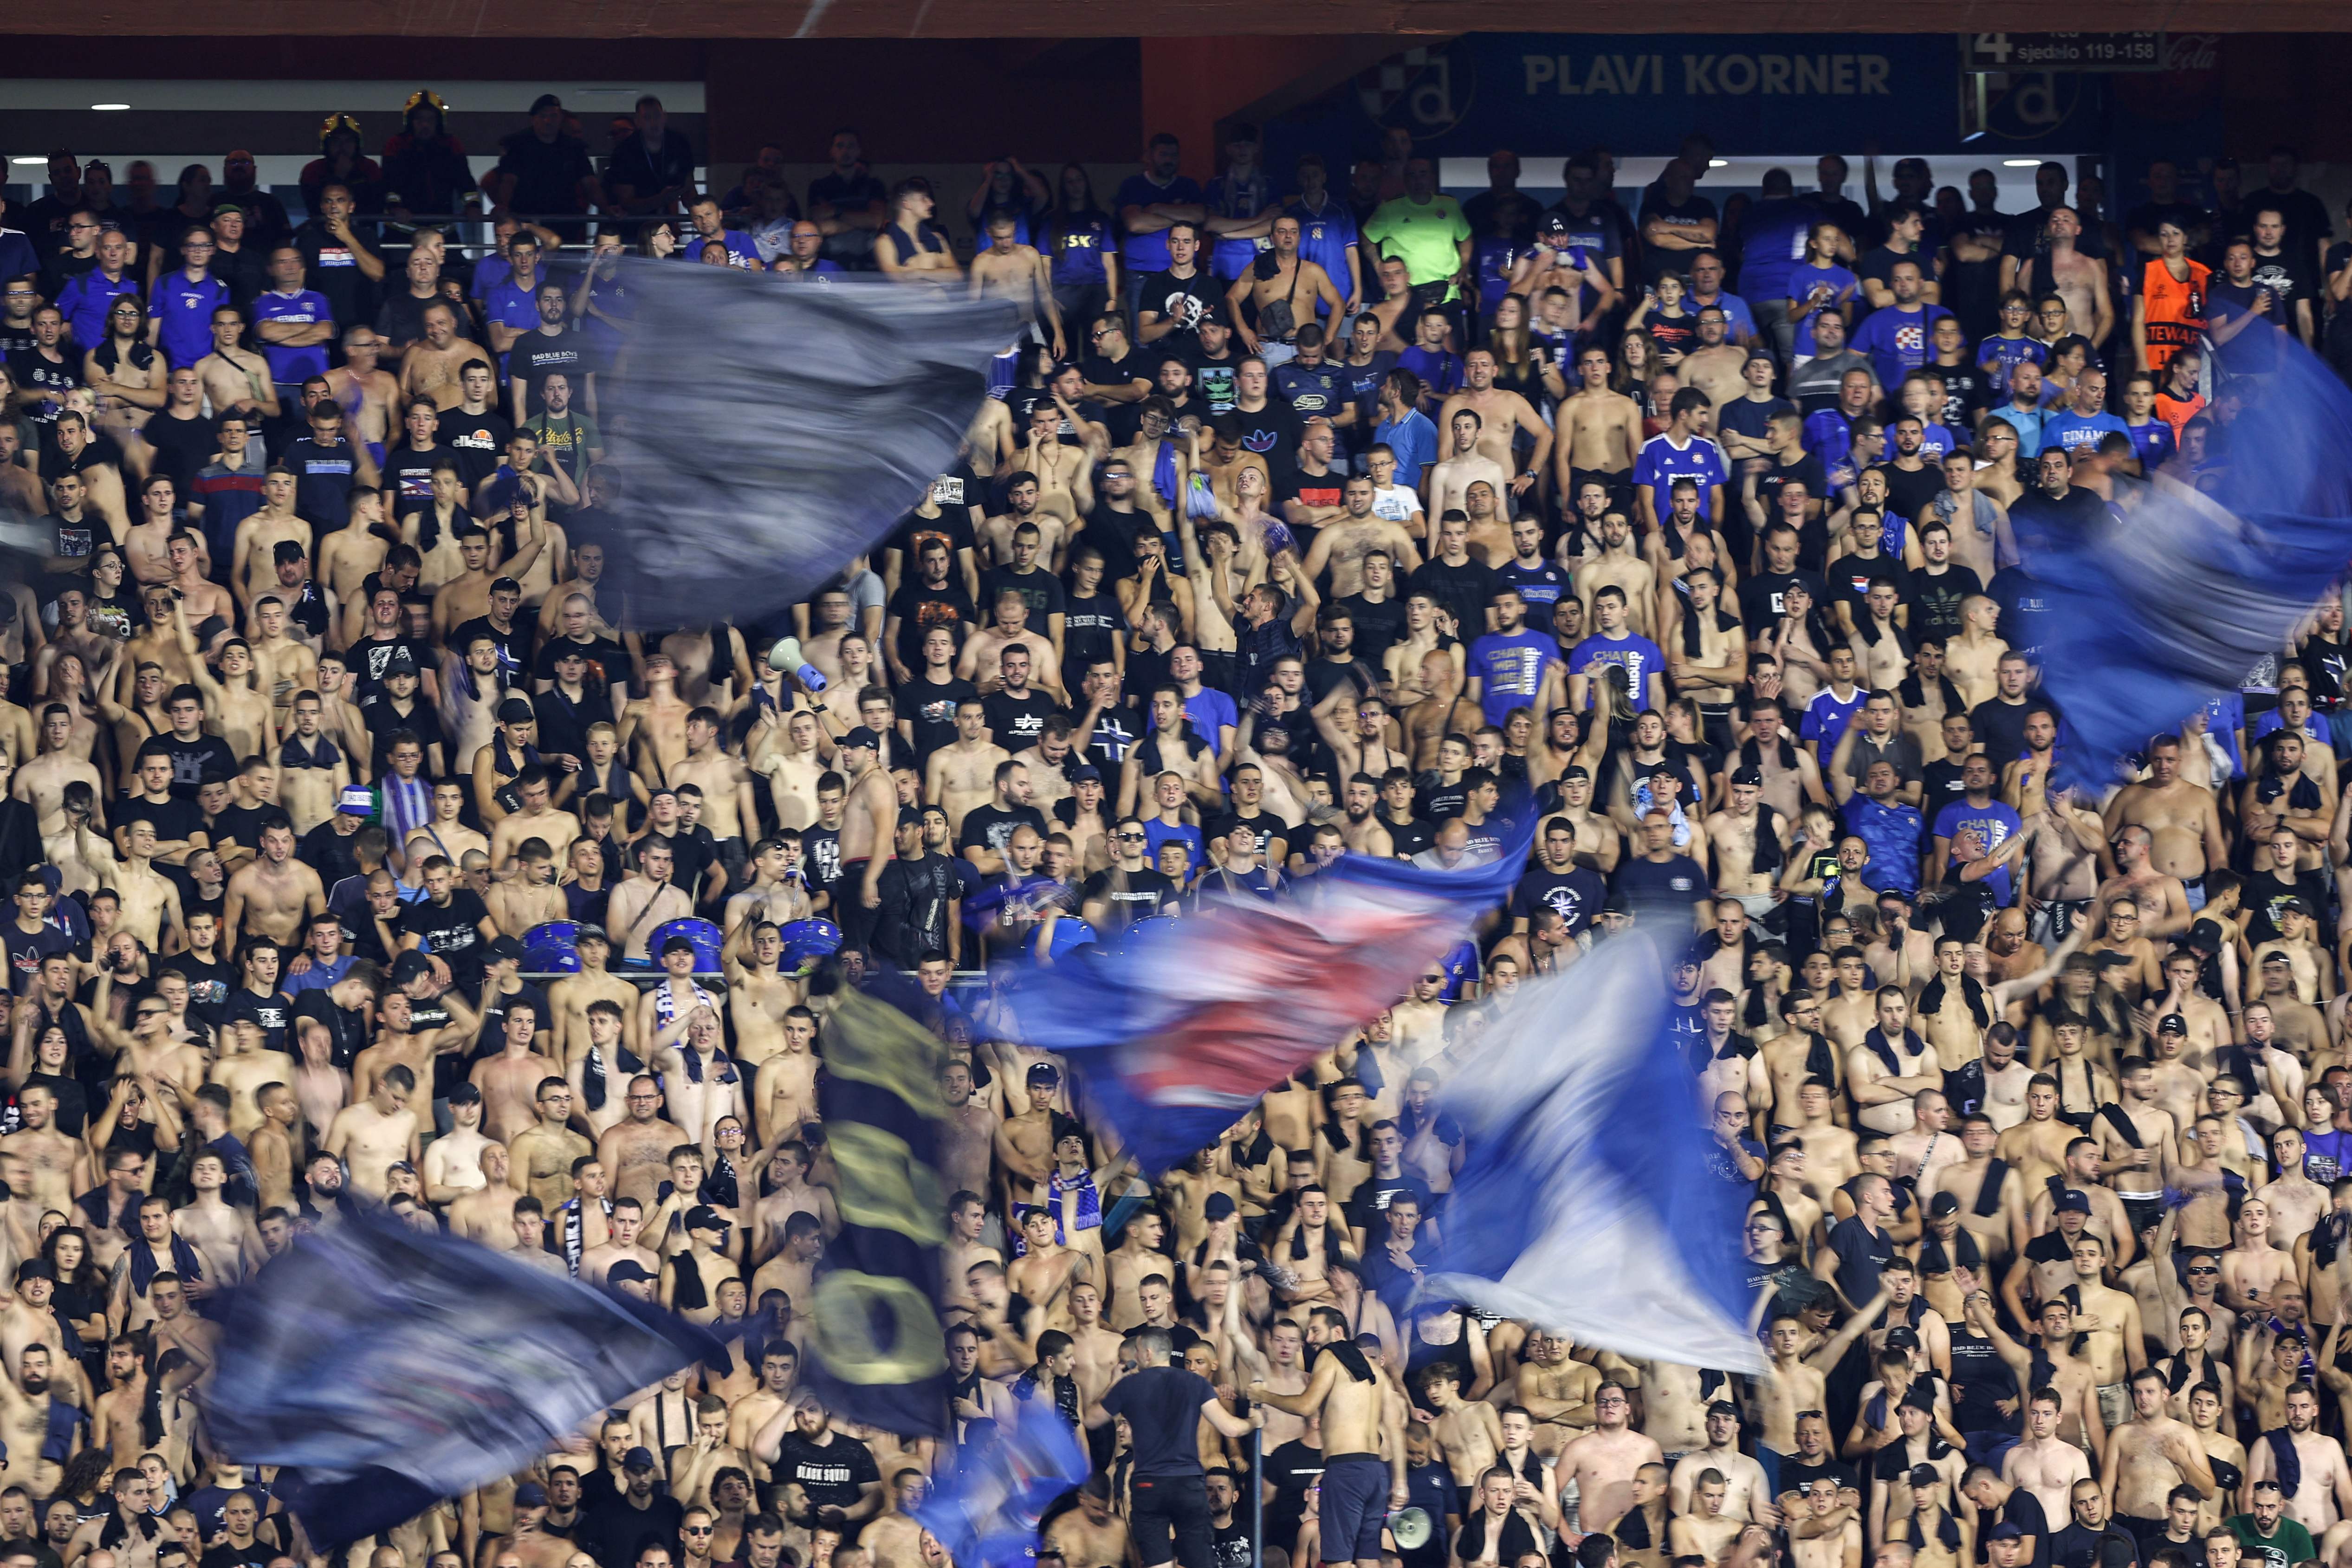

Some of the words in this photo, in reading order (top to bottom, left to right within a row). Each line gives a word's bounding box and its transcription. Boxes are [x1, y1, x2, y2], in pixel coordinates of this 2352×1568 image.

[1975, 32, 2014, 63] 4
[2086, 44, 2155, 58] 119-158
[1523, 55, 1663, 94] PLAVI
[1683, 55, 1891, 95] KORNER
[452, 435, 496, 450] ellesse
[1524, 647, 1543, 695] dinamo
[1629, 651, 1644, 700] dinamo
[2056, 902, 2065, 934] LACOSTE
[796, 1465, 823, 1481] BLACK
[823, 1468, 851, 1483] SQUAD
